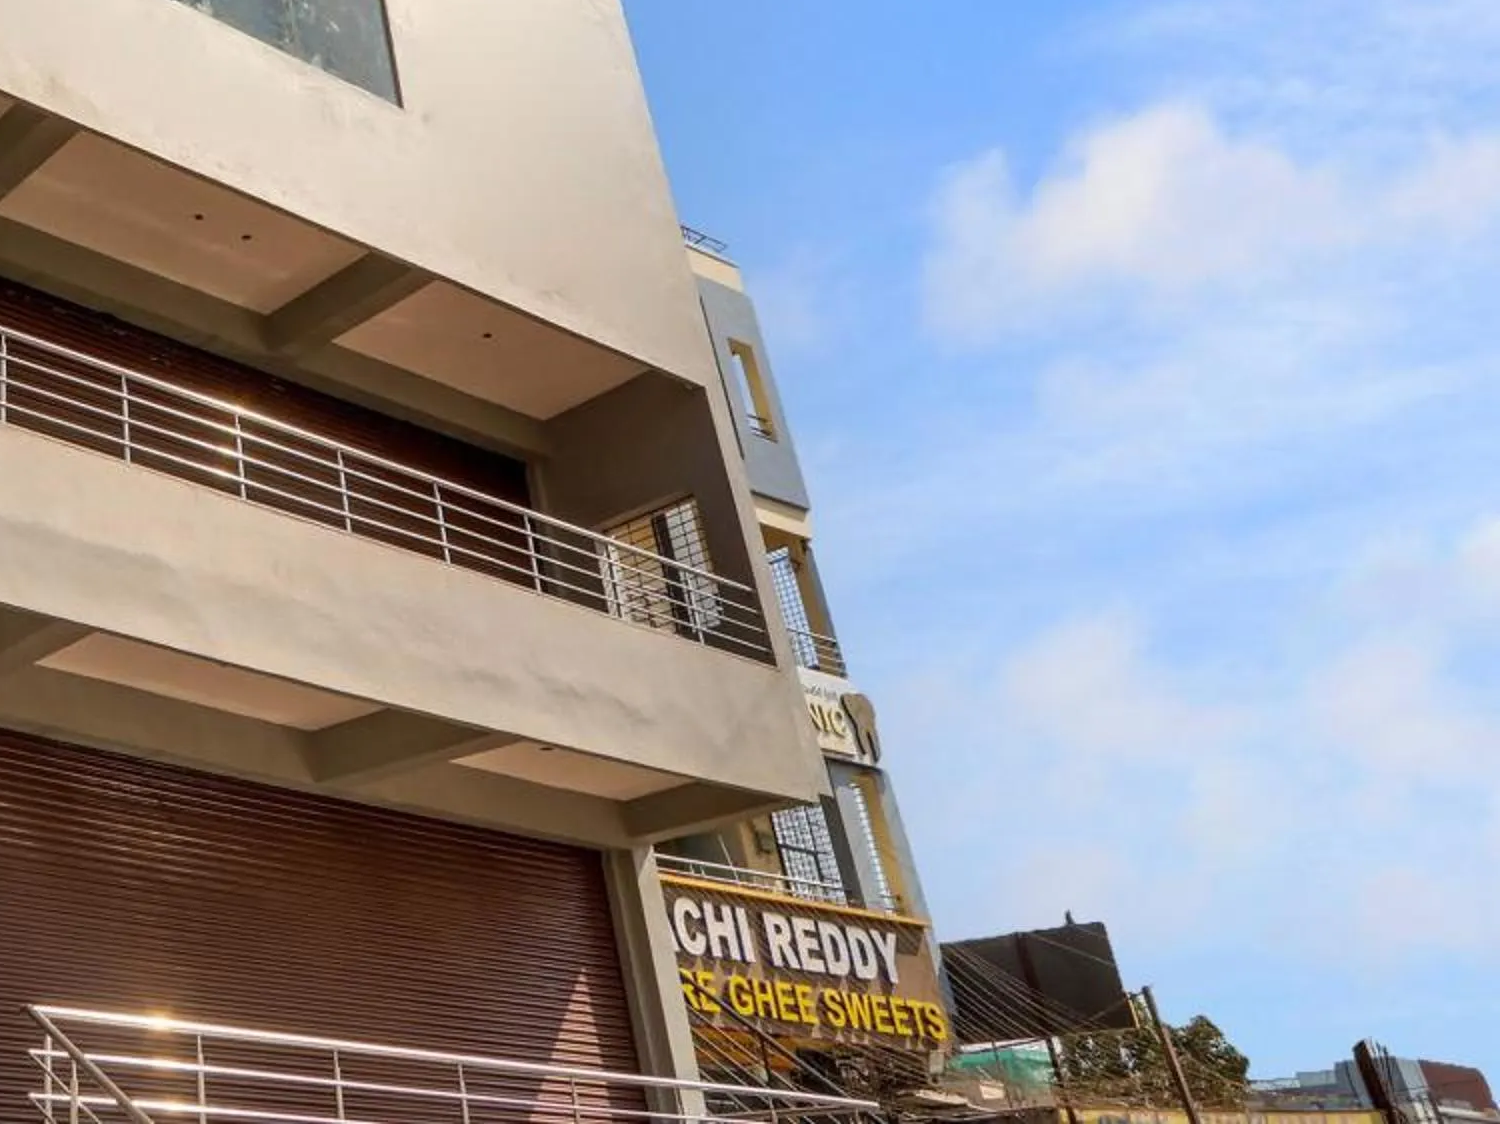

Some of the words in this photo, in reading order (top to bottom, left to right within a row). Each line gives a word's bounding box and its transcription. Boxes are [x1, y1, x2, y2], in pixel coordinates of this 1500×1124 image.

[668, 896, 757, 963] CHI
[763, 912, 898, 984] REDDY
[729, 974, 819, 1026] GHEE
[824, 989, 946, 1041] SWEETS
